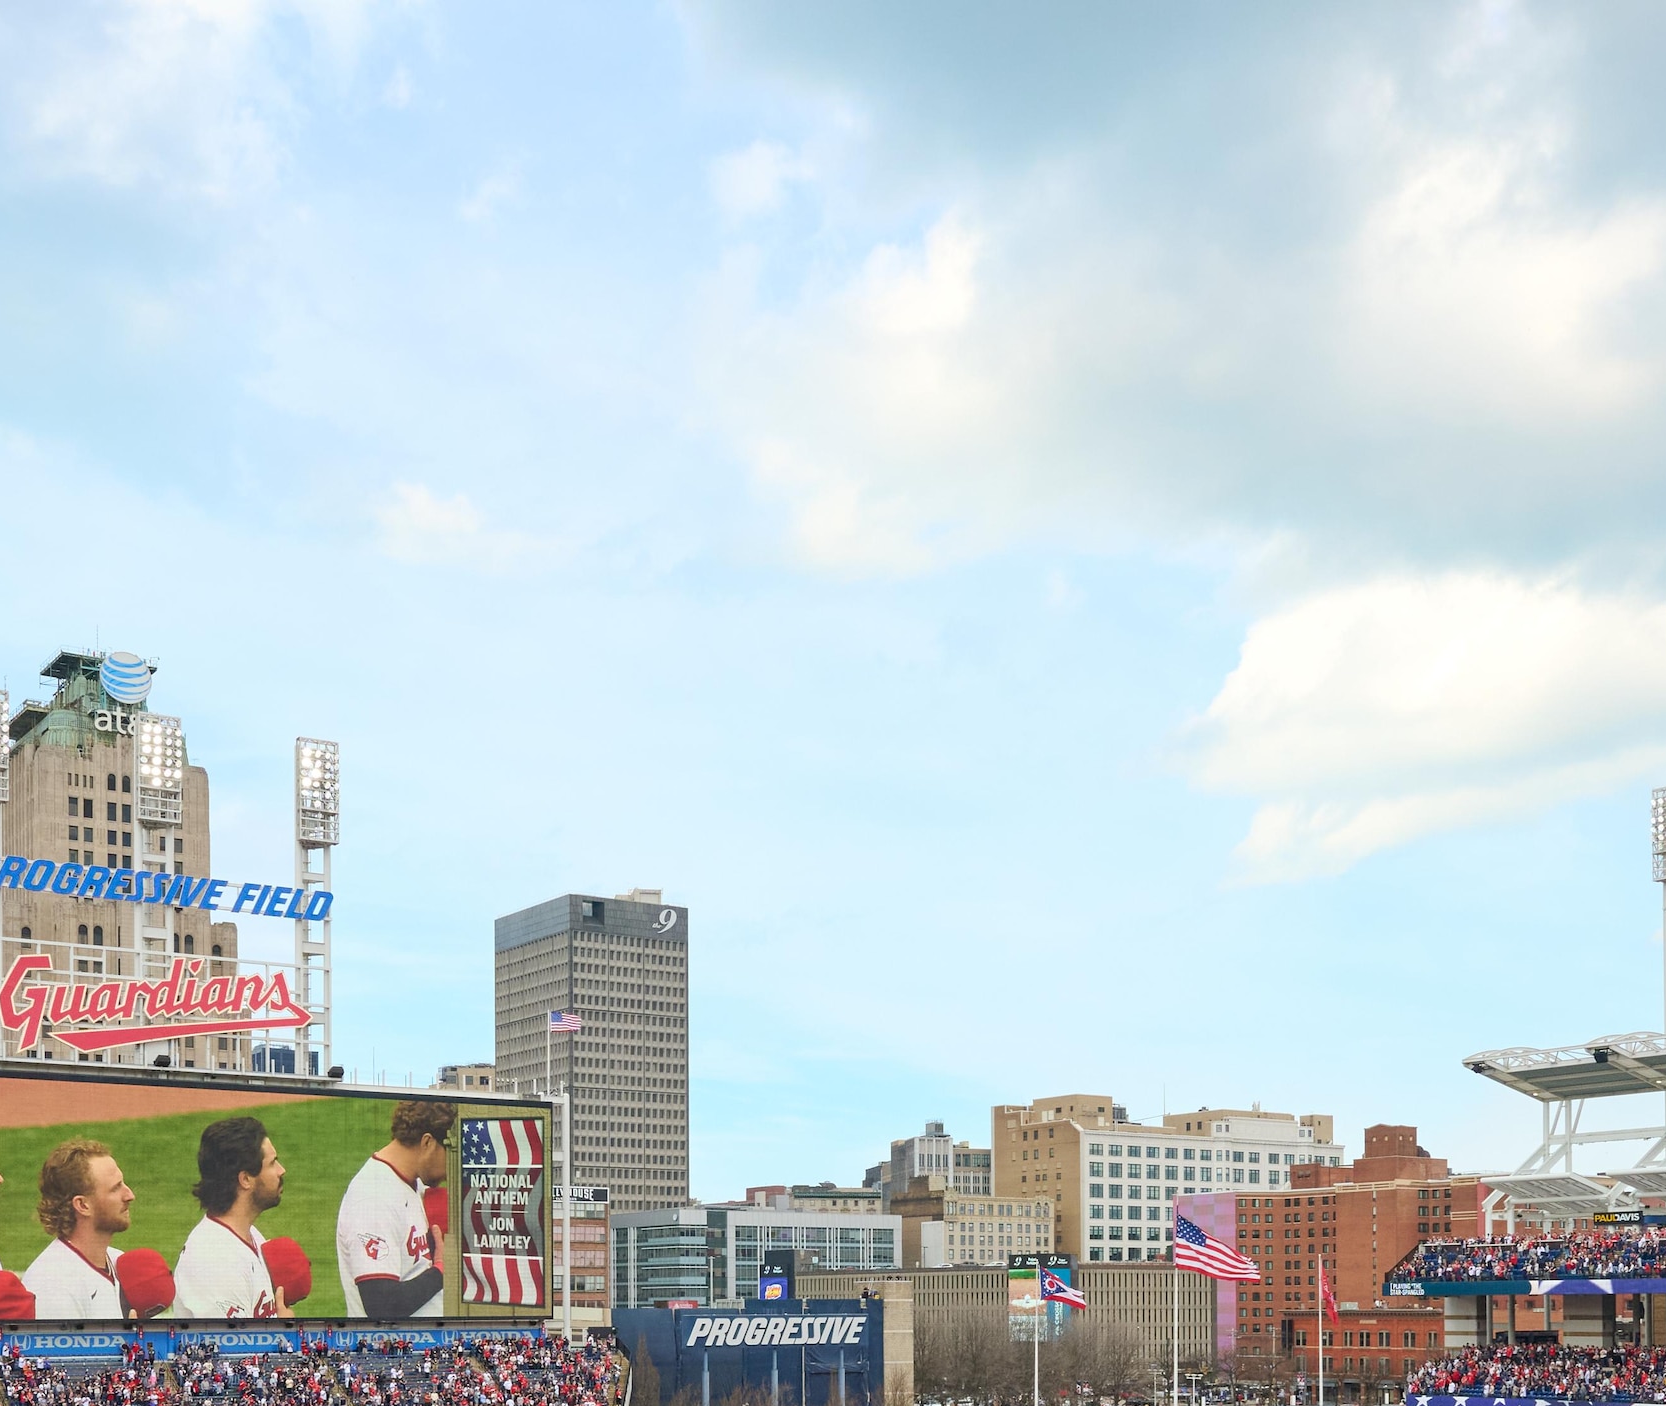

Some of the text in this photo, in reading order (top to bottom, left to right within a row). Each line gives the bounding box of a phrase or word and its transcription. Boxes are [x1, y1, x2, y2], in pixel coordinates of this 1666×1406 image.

[231, 882, 334, 921] FIELD
[657, 909, 677, 934] 9
[470, 1173, 534, 1189] NATIONAL
[475, 1190, 529, 1206] ANTHEM
[489, 1217, 514, 1232] JON
[473, 1233, 531, 1250] LAMPLEY
[199, 1333, 289, 1345] HONDA
[355, 1332, 436, 1344] HONDA
[460, 1330, 536, 1344] HONDA
[686, 1316, 867, 1347] PROGRESSIVE
[33, 1335, 127, 1348] HONDA
